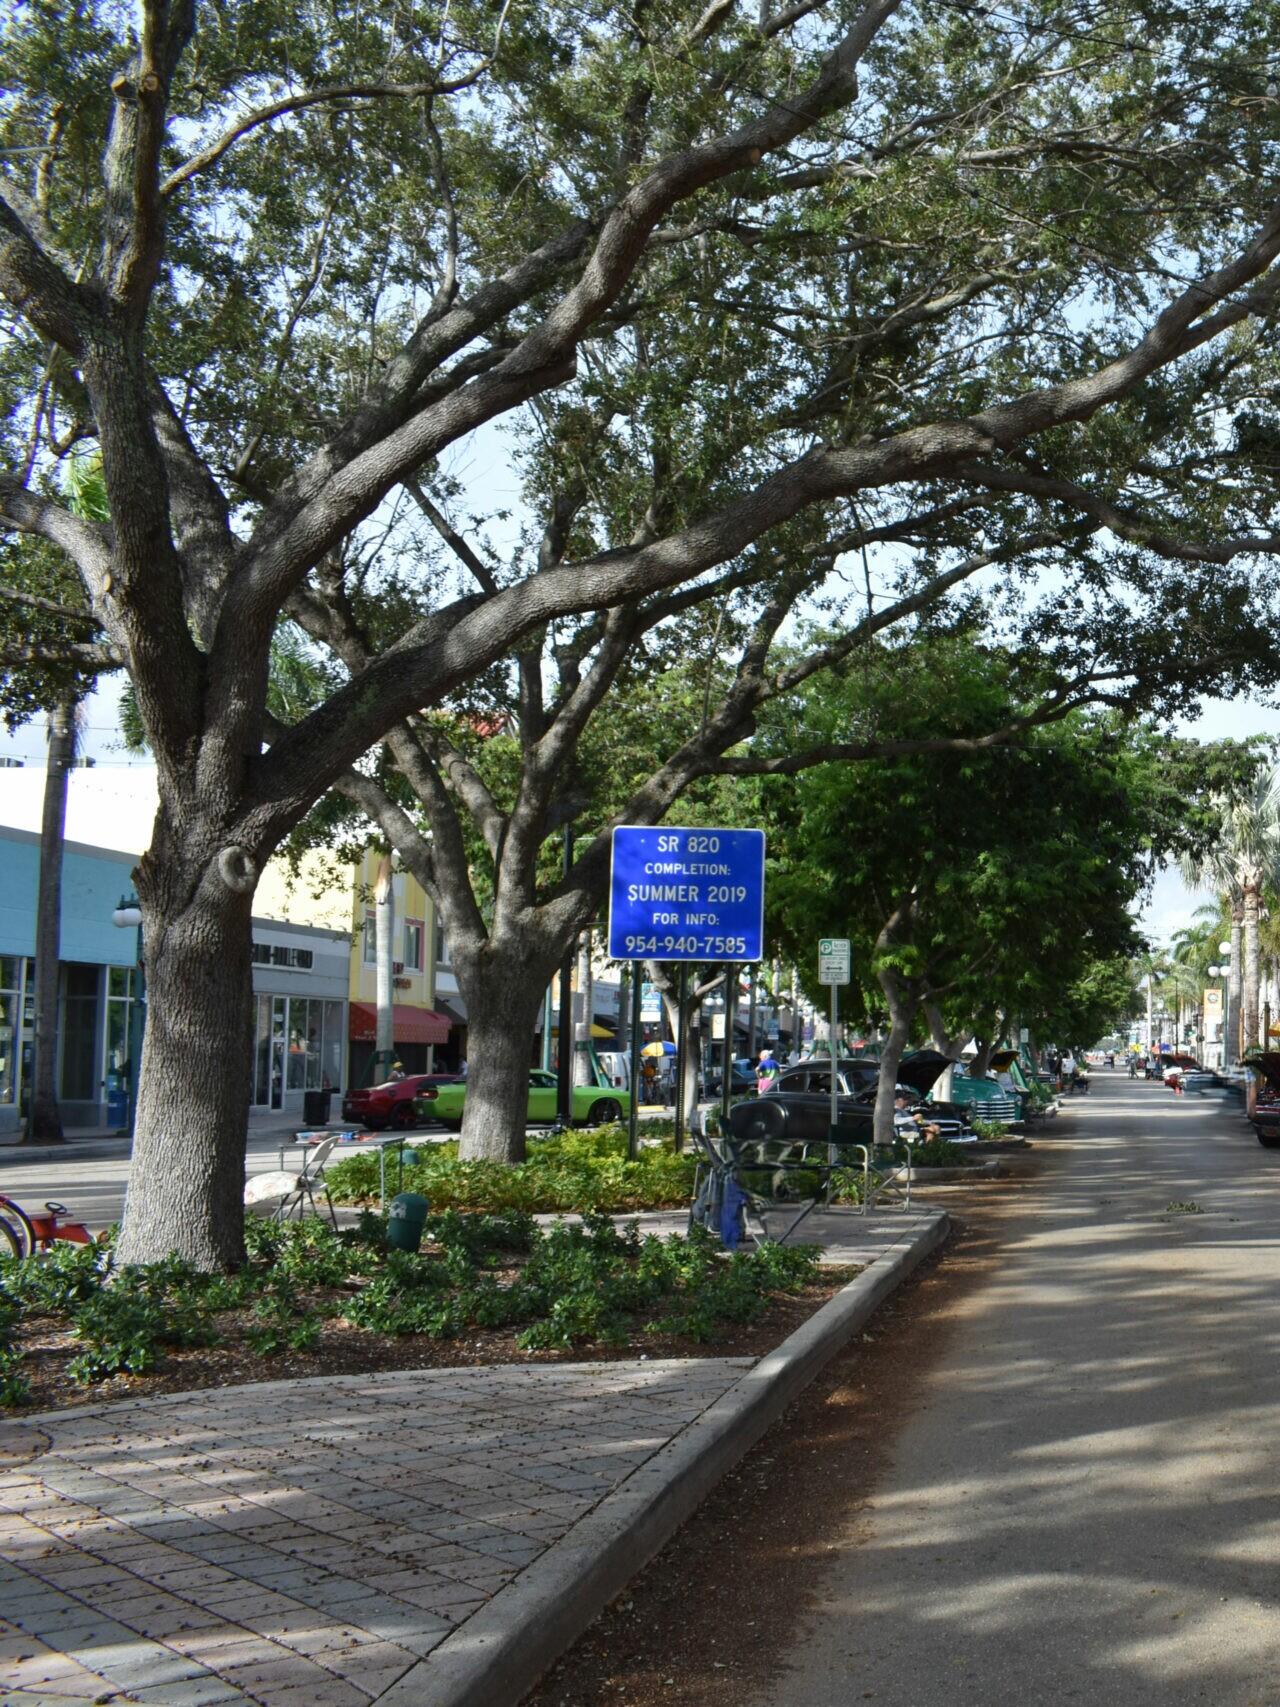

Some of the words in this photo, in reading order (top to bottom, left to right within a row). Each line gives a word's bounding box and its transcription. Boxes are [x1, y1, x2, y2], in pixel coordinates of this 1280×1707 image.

[657, 836, 679, 852] SR
[688, 837, 720, 853] 820
[644, 863, 732, 876] COMPLETION:
[627, 885, 699, 902] SUMMER
[707, 886, 747, 903] 2019
[652, 913, 679, 925] FOR
[686, 913, 720, 925] INFO:
[625, 936, 746, 953] 954-940-7585
